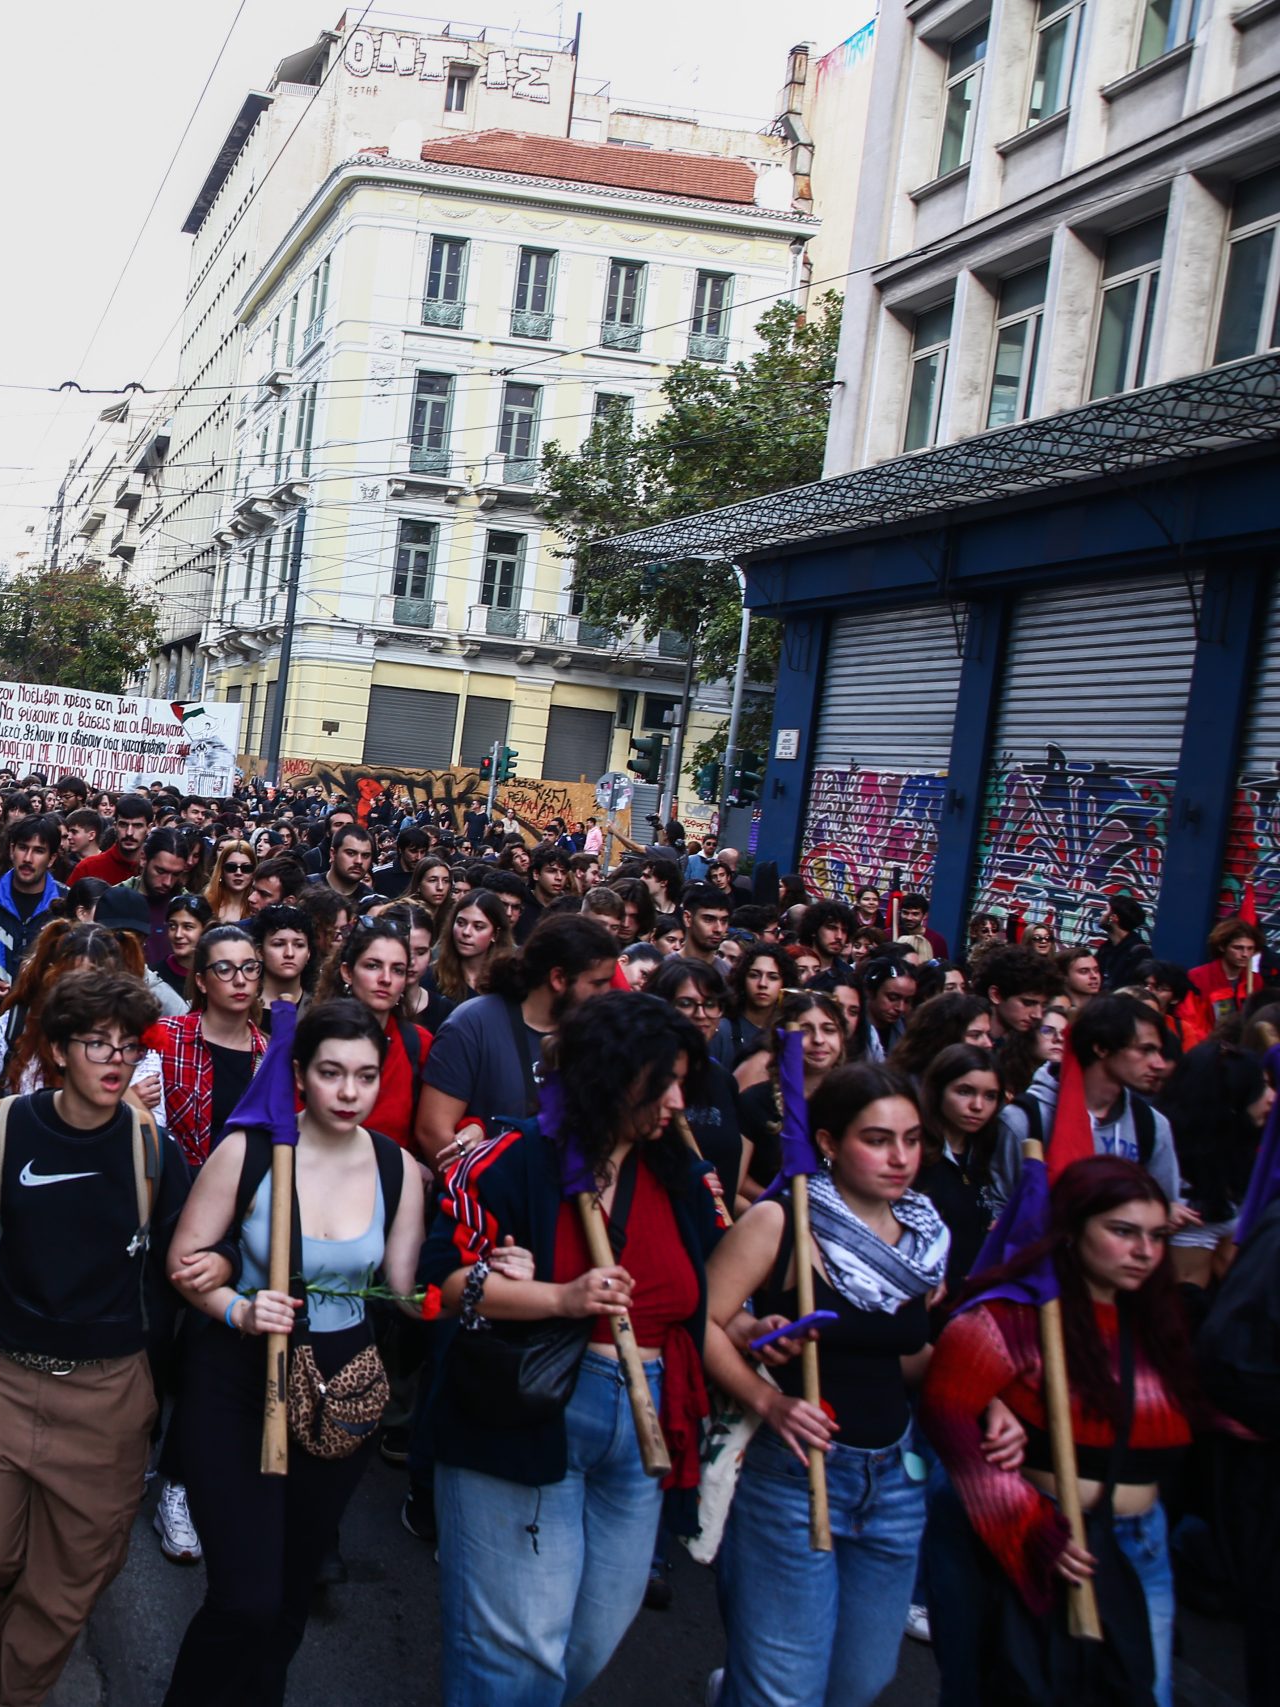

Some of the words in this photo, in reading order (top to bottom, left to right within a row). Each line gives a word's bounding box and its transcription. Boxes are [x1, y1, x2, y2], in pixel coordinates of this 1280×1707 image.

[62, 711, 73, 727] οι
[113, 719, 128, 733] και
[129, 720, 141, 733] οι
[38, 743, 53, 764] ΜΕ
